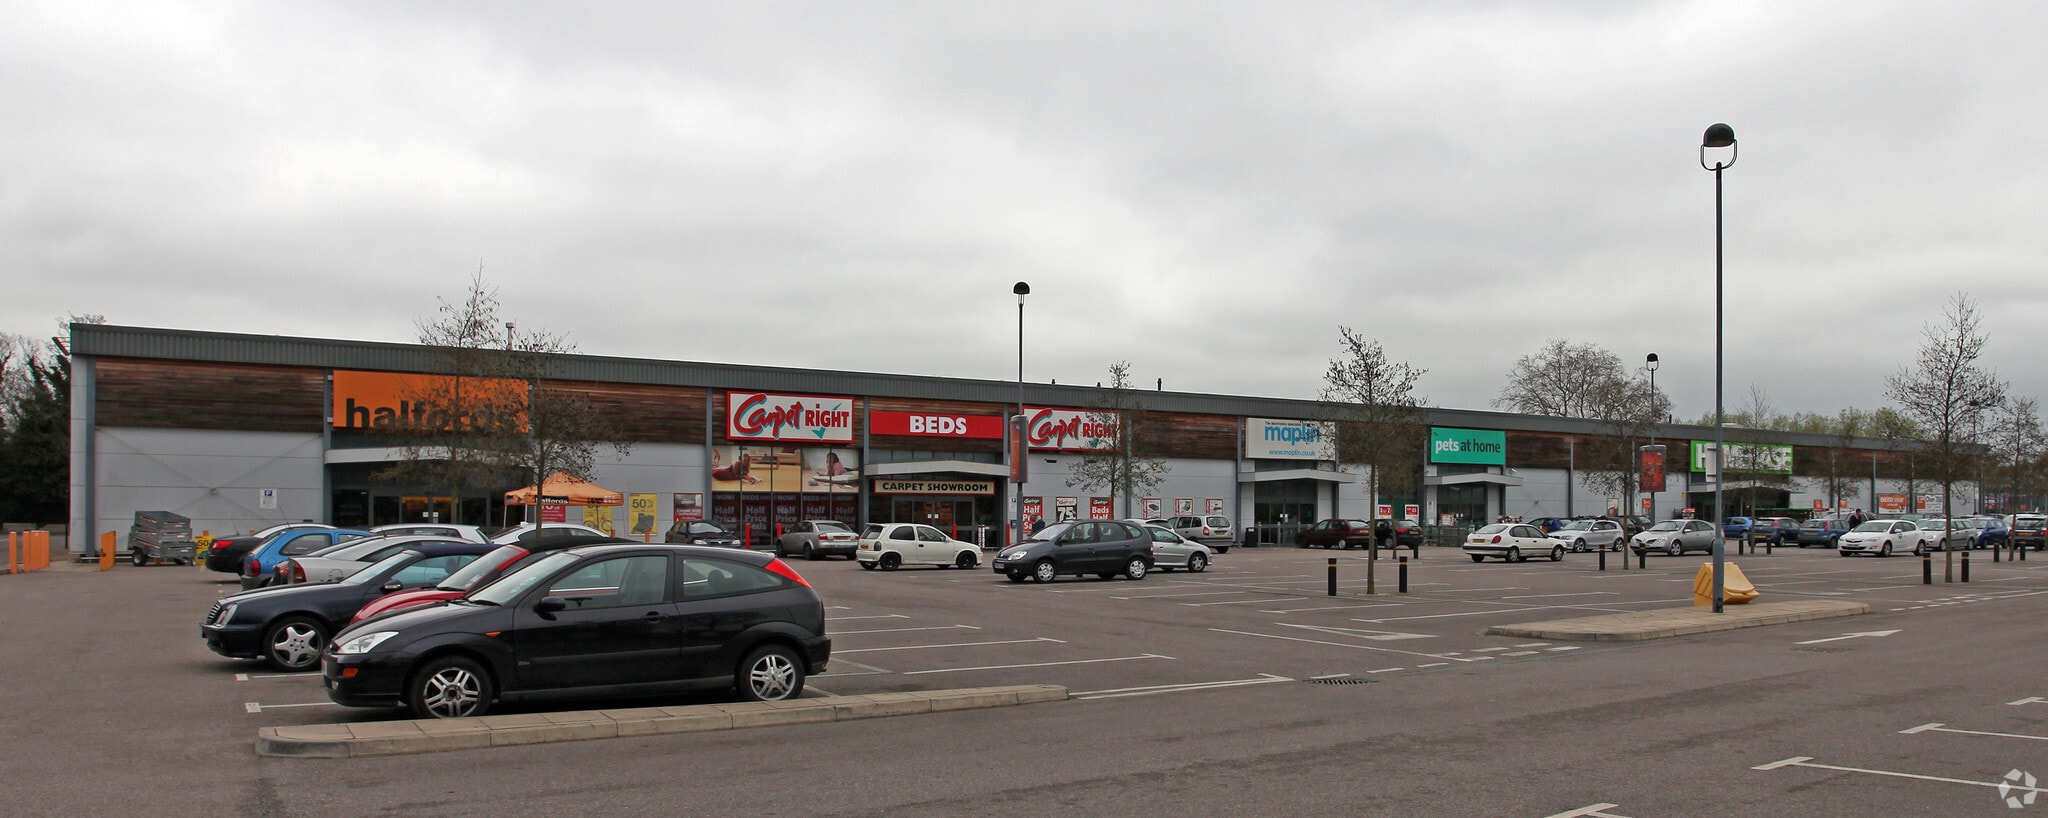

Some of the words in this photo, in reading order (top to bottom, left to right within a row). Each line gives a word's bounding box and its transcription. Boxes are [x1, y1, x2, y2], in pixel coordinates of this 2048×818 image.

[734, 393, 803, 440] Carpet
[805, 404, 850, 429] RIGHT
[910, 416, 967, 434] BEDS
[1028, 408, 1081, 449] Carpet
[1264, 423, 1321, 446] maplin
[1435, 439, 1459, 454] pets
[1461, 441, 1471, 452] at
[1473, 439, 1501, 453] home
[882, 482, 924, 491] CARPET
[927, 483, 988, 492] SHOWROOM
[536, 496, 568, 504] alfords
[632, 499, 646, 508] 50
[777, 506, 796, 514] Half
[806, 506, 825, 514] Half
[836, 506, 854, 514] Half
